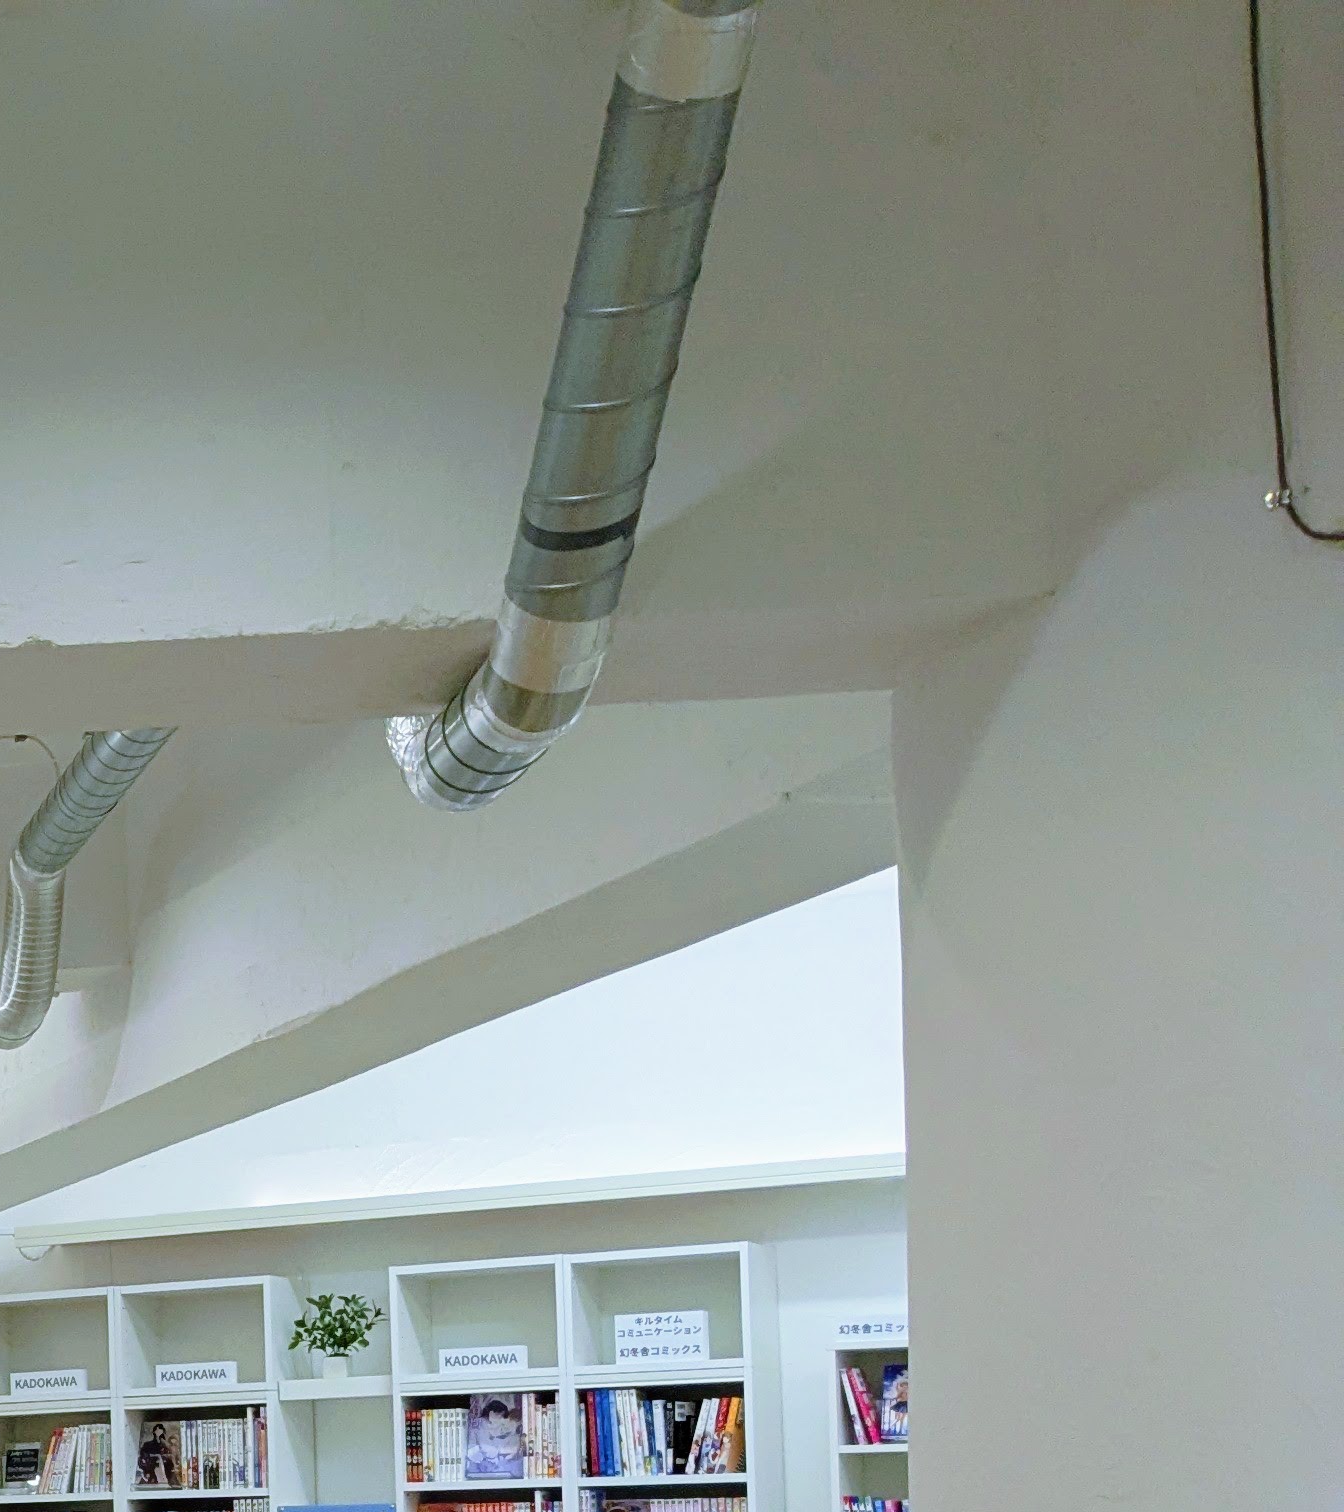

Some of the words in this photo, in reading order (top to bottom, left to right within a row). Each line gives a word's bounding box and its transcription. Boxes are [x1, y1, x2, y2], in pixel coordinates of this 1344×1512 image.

[634, 1315, 683, 1326] キルタイム
[617, 1325, 702, 1338] コミュニケーション
[838, 1322, 908, 1335] 幻冬舎コミッ
[619, 1344, 702, 1358] 幻冬舎コミックス
[444, 1352, 518, 1367] KADOKAWA
[161, 1368, 227, 1382] KADOKAWA
[15, 1375, 78, 1390] KADOKAWA
